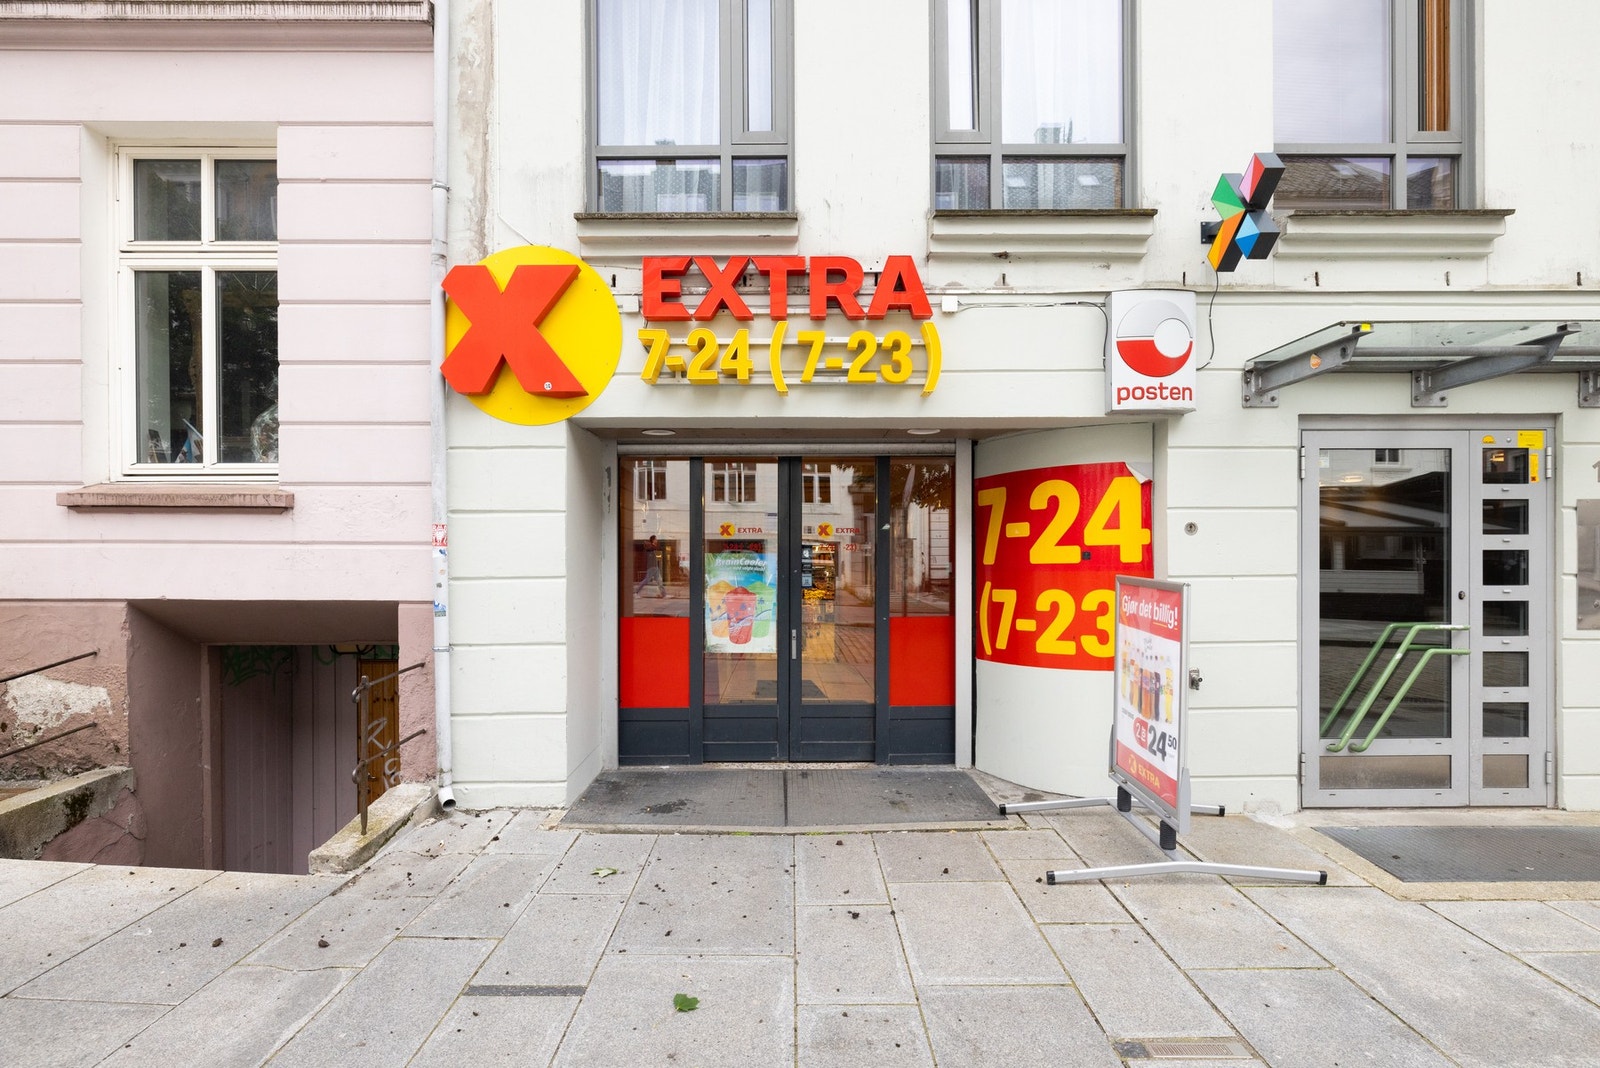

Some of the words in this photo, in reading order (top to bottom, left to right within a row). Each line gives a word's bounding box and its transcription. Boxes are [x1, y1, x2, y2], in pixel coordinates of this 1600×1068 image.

[642, 255, 933, 321] EXTRA
[638, 328, 754, 385] 7-24
[1117, 382, 1193, 405] posten
[978, 476, 1151, 565] 7-24
[1122, 595, 1138, 617] Gjør
[1139, 600, 1152, 619] det
[1153, 602, 1178, 629] billig!
[1135, 722, 1141, 738] 2
[1138, 763, 1160, 789] EXTRA
